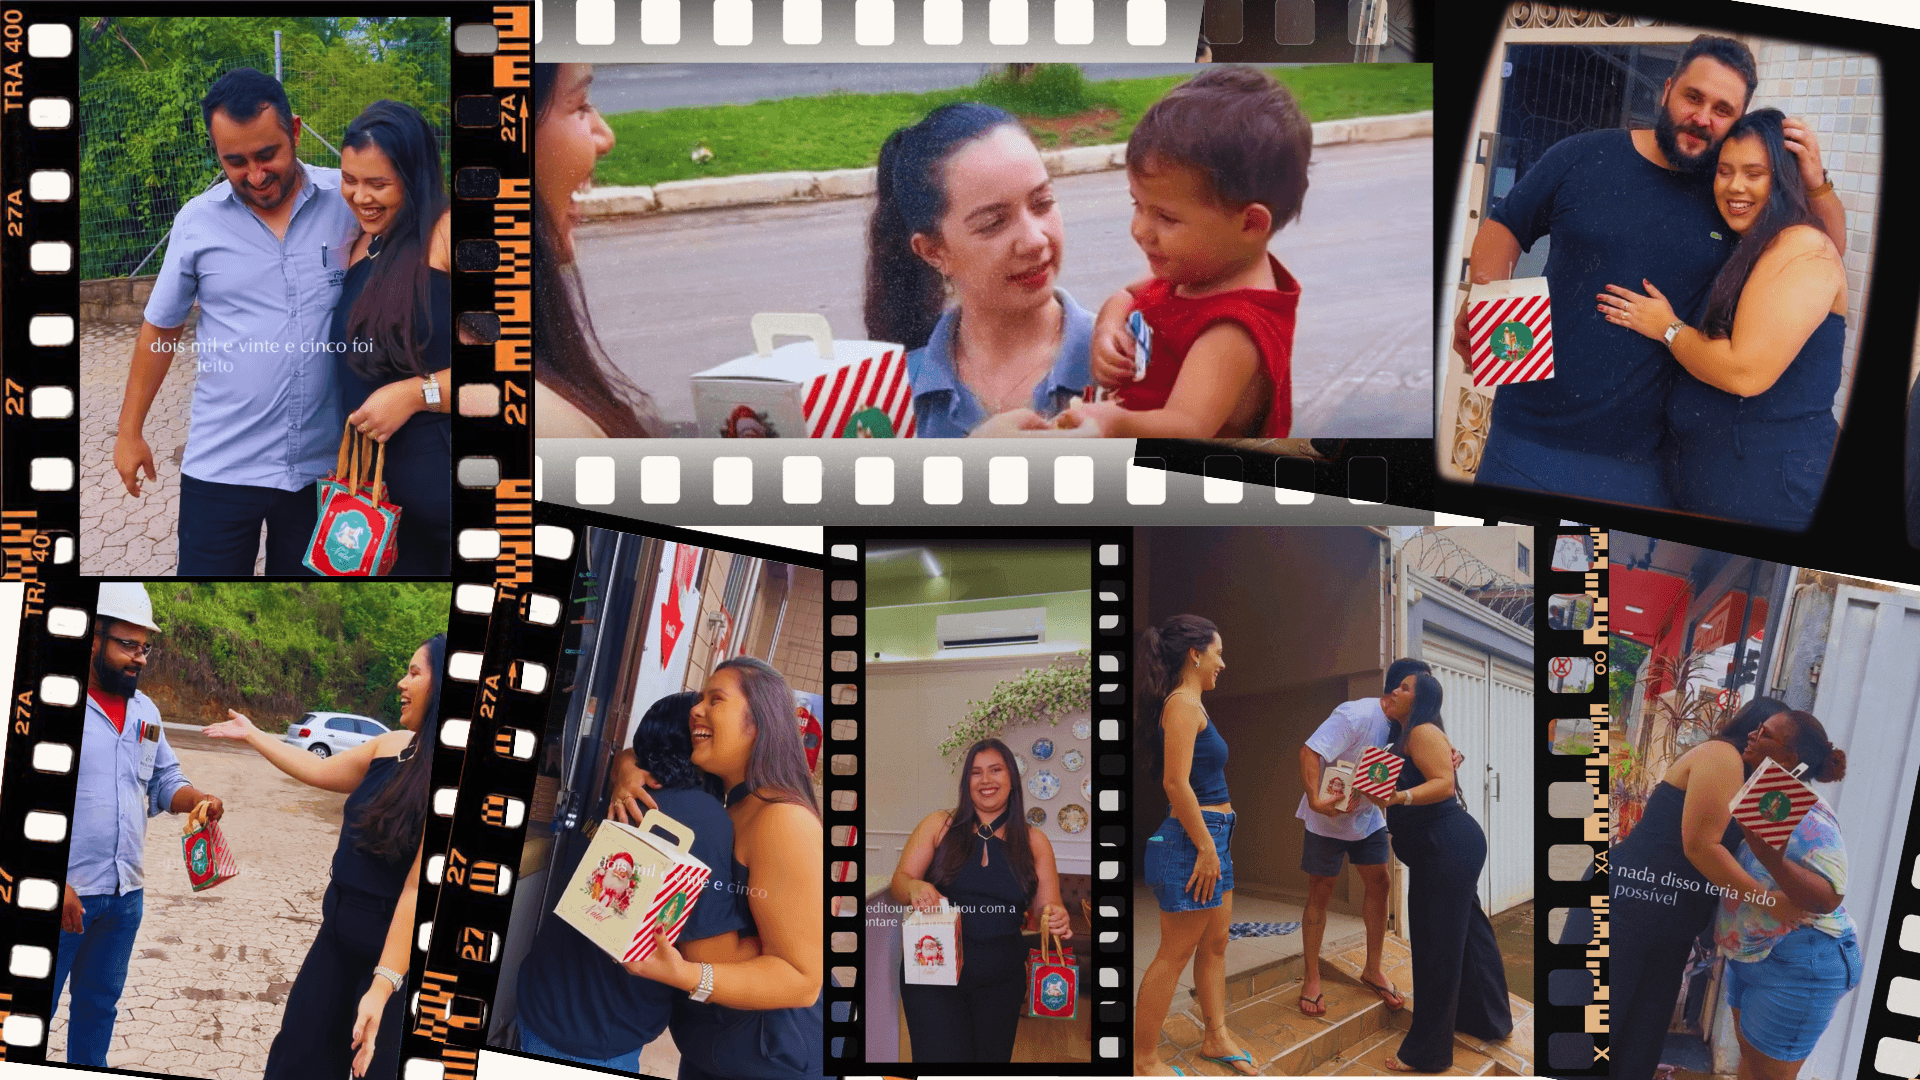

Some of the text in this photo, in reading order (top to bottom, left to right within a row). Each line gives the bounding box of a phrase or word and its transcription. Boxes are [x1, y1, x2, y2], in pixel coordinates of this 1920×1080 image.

[4, 9, 23, 114] TRA 400
[500, 93, 516, 142] 27A
[7, 189, 23, 237] 27A
[5, 378, 25, 416] 27
[505, 380, 526, 426] 27
[15, 690, 33, 735] 27A
[480, 674, 501, 719] 27A
[446, 848, 467, 886] 27
[1594, 850, 1609, 875] XA
